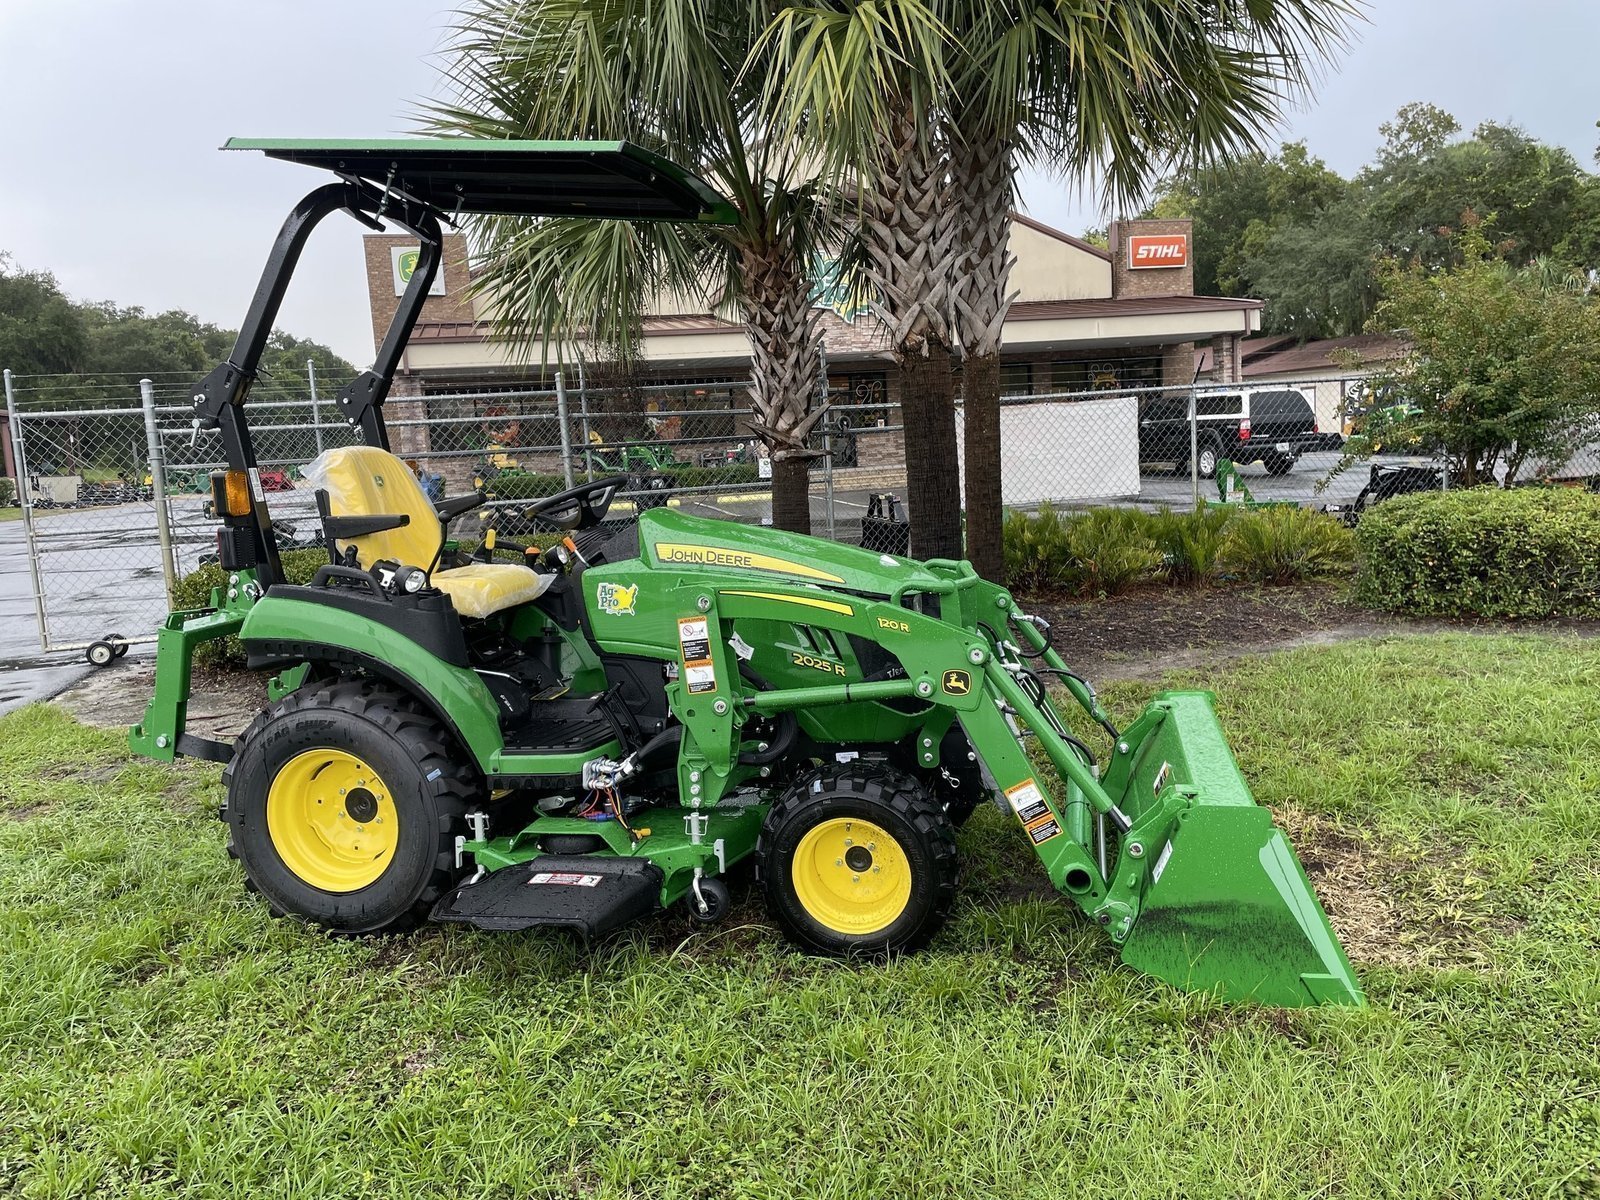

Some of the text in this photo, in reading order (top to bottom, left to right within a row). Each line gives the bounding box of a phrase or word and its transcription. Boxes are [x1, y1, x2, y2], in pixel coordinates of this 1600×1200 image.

[1136, 244, 1183, 259] STIHL
[667, 548, 752, 567] JOHN DEERE
[600, 596, 619, 608] Pro
[877, 617, 911, 634] 120 R
[791, 652, 847, 678] 2025 R
